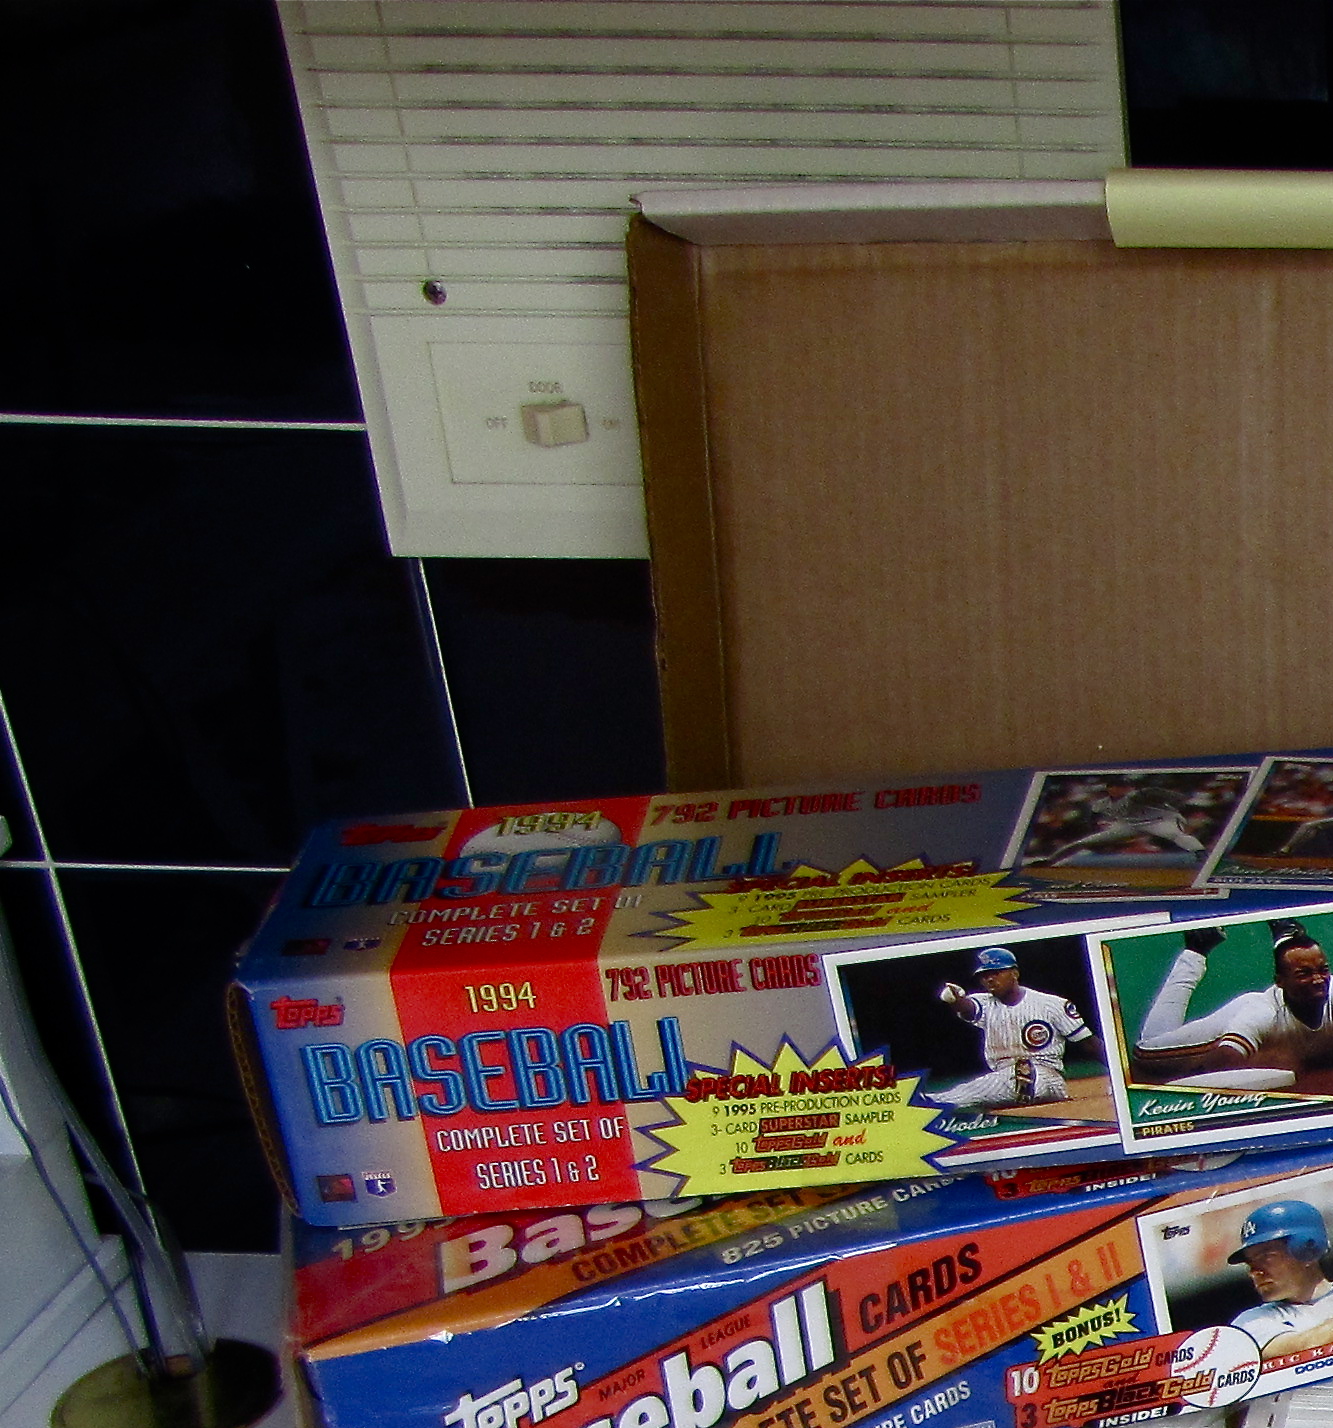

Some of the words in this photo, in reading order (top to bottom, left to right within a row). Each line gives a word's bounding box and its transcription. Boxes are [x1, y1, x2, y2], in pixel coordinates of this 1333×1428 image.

[486, 417, 508, 429] OFF
[651, 801, 720, 827] 792
[726, 790, 867, 821] PICTURE
[304, 828, 793, 910] BASEBALL
[388, 901, 538, 927] COMPLETE
[551, 897, 606, 914] SET
[422, 922, 521, 947] SERIES
[577, 918, 595, 936] 2
[604, 967, 651, 1002] 792
[653, 960, 747, 999] PICTURE
[748, 953, 823, 992] CARDS
[463, 980, 537, 1014] 1994
[300, 1016, 691, 1129] BASEBALL
[684, 1074, 785, 1104] SPECIAL
[789, 1065, 898, 1094] INSERTS!
[724, 1103, 757, 1117] 1995
[760, 1096, 861, 1114] PRE-PRODUCTION
[862, 1091, 902, 1106] CARDS
[1138, 1096, 1197, 1119] Kevin
[1199, 1090, 1269, 1112] Young
[435, 1125, 548, 1153] COMPLETE
[551, 1121, 595, 1146] SET
[600, 1117, 626, 1142] OF
[725, 1121, 758, 1135] CARD
[760, 1113, 840, 1132] SUPERSTAR
[845, 1111, 895, 1125] SAMPLER
[1142, 1122, 1195, 1137] PIRATES
[736, 1142, 748, 1153] 10
[832, 1129, 868, 1146] and
[845, 1151, 883, 1165] CARDS
[475, 1161, 549, 1191] SERIES
[569, 1161, 582, 1182] &
[584, 1156, 600, 1180] 2
[1084, 1173, 1157, 1193] INSIDE!
[720, 1231, 784, 1265] 825
[788, 1195, 889, 1240] PICTURE
[859, 1242, 983, 1334] CARDS
[822, 1365, 882, 1423] SET
[886, 1340, 927, 1389] OF
[933, 1284, 1042, 1365] SERIES
[1068, 1259, 1094, 1297] &
[1051, 1308, 1121, 1351] BONUS!
[598, 1368, 646, 1401] MAJOR
[698, 1312, 753, 1352] LEAGUE
[1009, 1367, 1040, 1398] 10
[1155, 1347, 1195, 1367] CARDS
[1218, 1368, 1256, 1389] CARDS
[909, 1381, 972, 1425] CARDS
